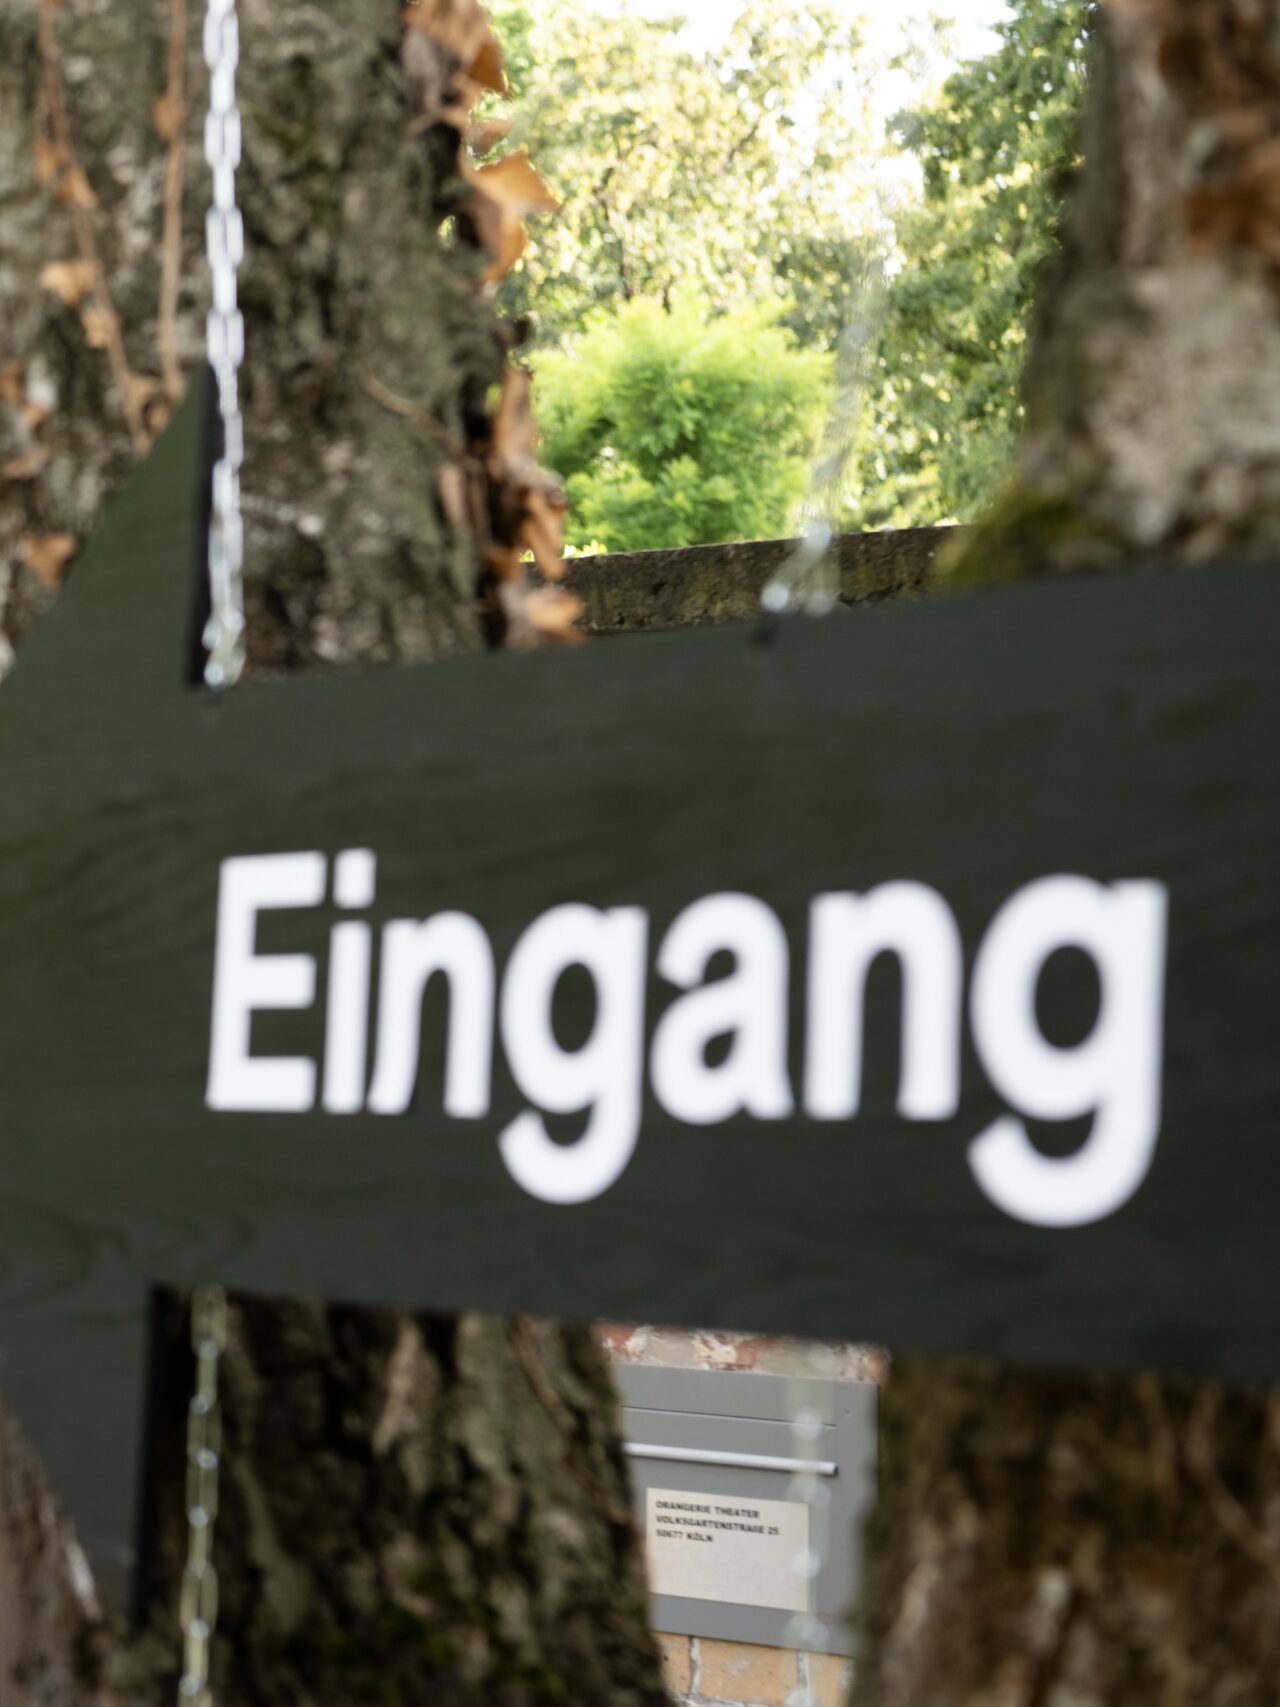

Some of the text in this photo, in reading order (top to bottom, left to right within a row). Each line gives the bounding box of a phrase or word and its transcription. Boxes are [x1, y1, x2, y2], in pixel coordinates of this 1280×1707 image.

[204, 847, 1169, 1229] Eingang
[655, 1500, 760, 1519] ORANGERIE THEATER
